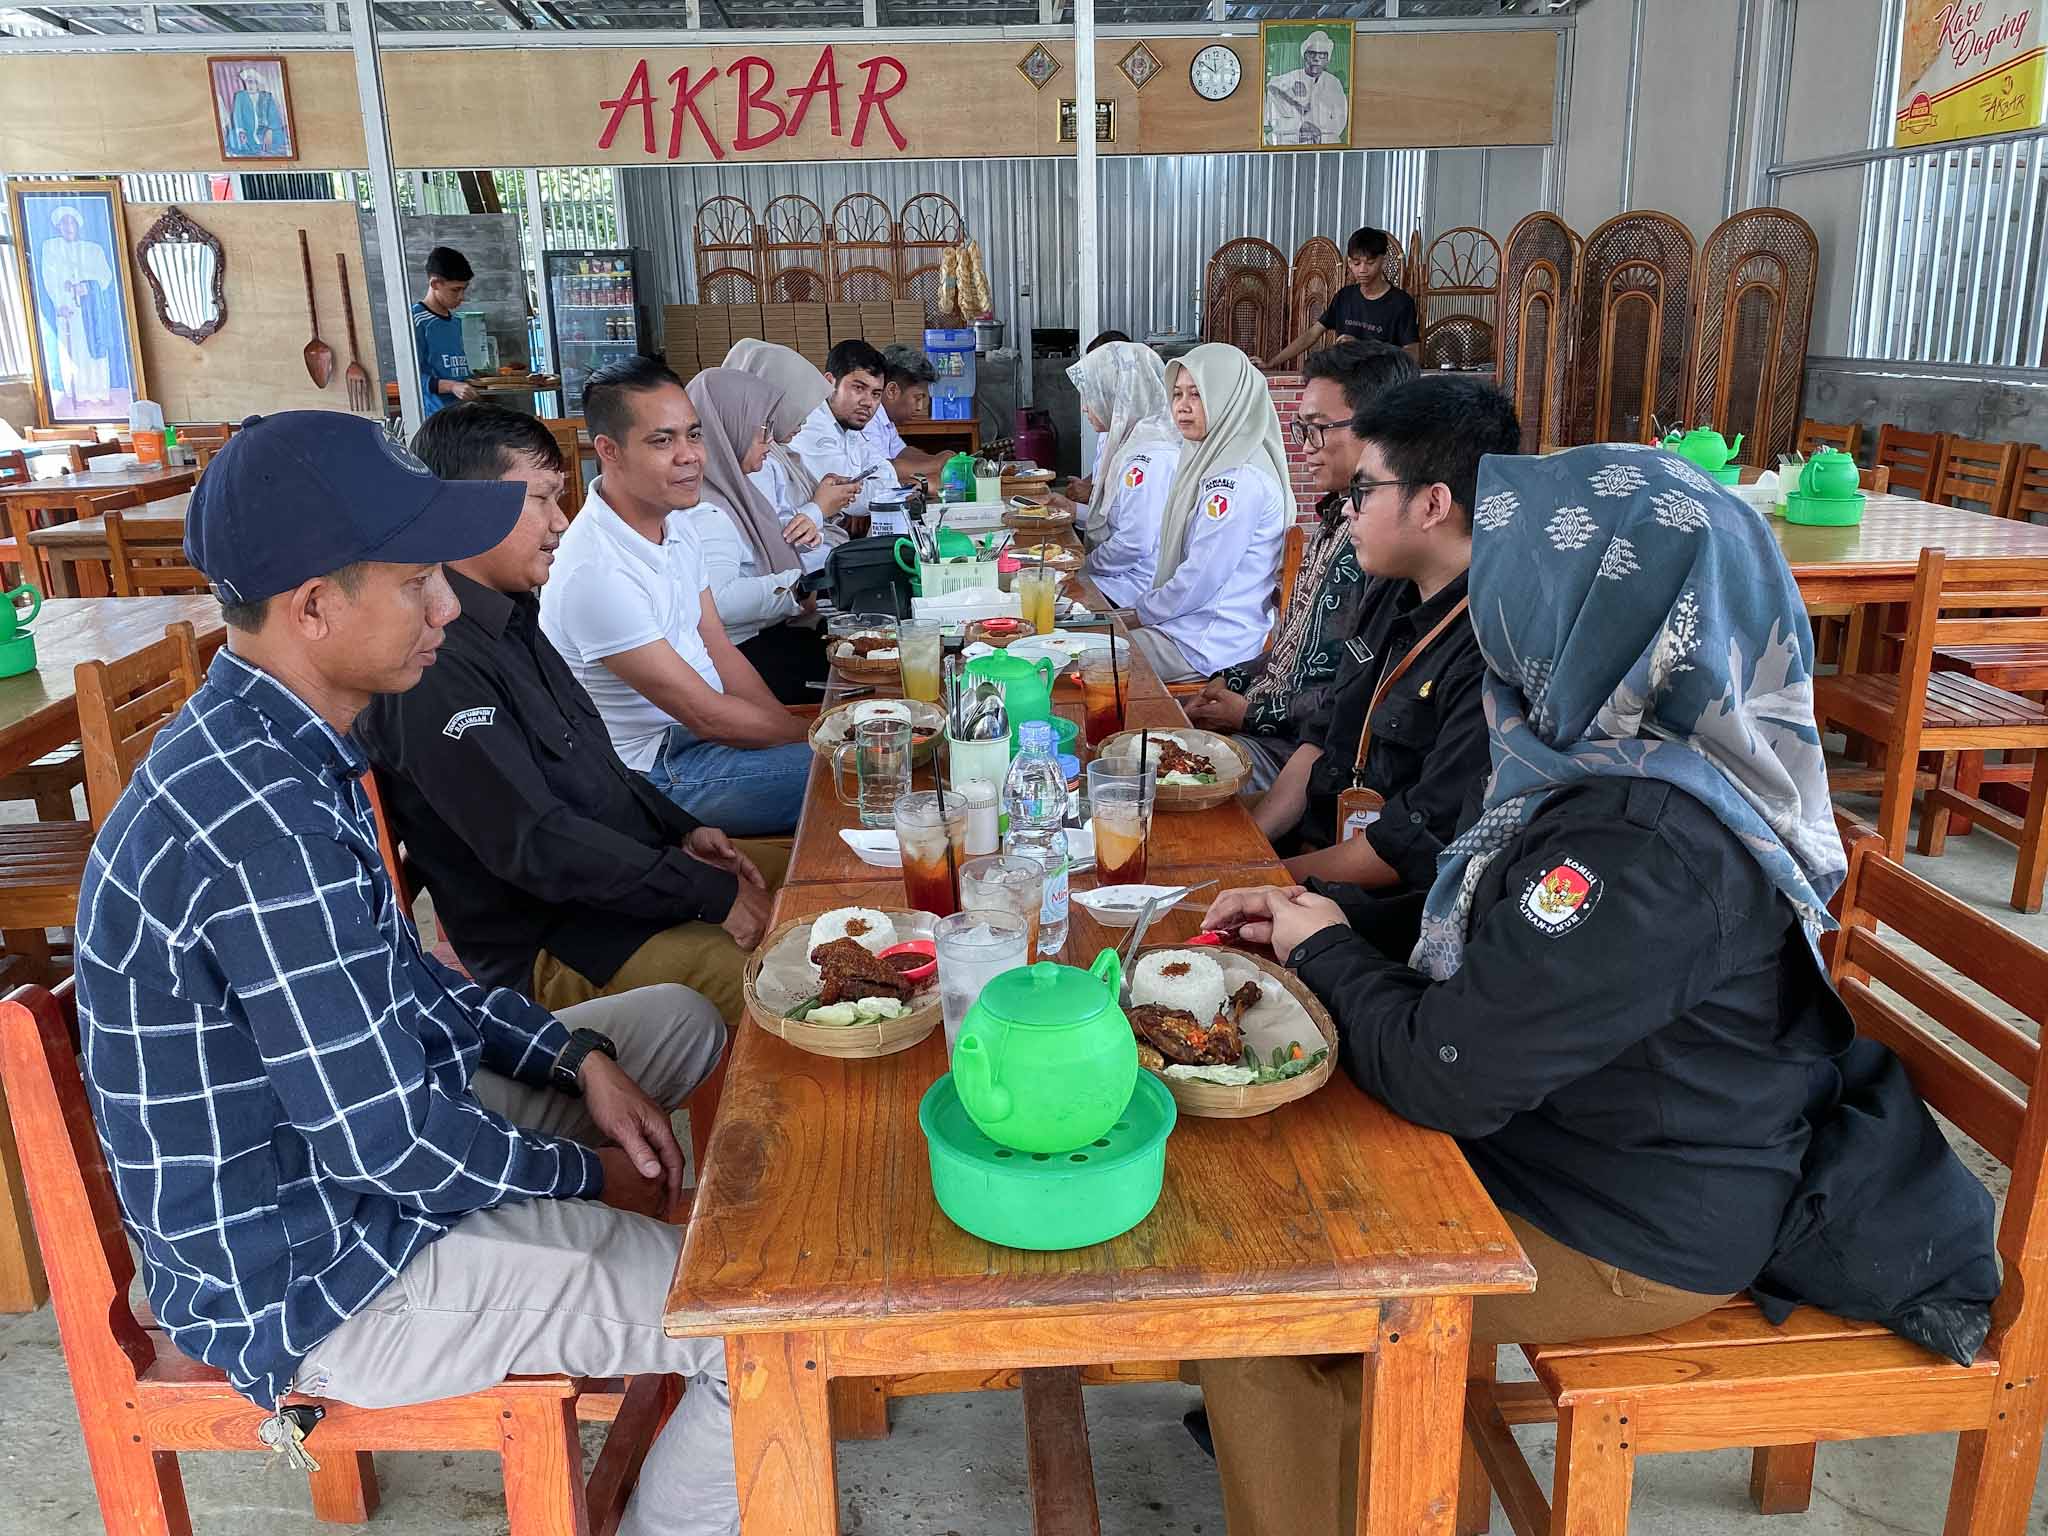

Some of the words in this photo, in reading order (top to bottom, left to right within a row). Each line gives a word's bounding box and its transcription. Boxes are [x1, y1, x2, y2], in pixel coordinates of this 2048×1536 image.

[1935, 0, 1986, 47] Kare
[1952, 9, 2032, 69] Daging
[598, 44, 908, 160] AKBAR
[1983, 93, 2026, 122] AKBAR
[1563, 856, 1598, 888] KOMISI
